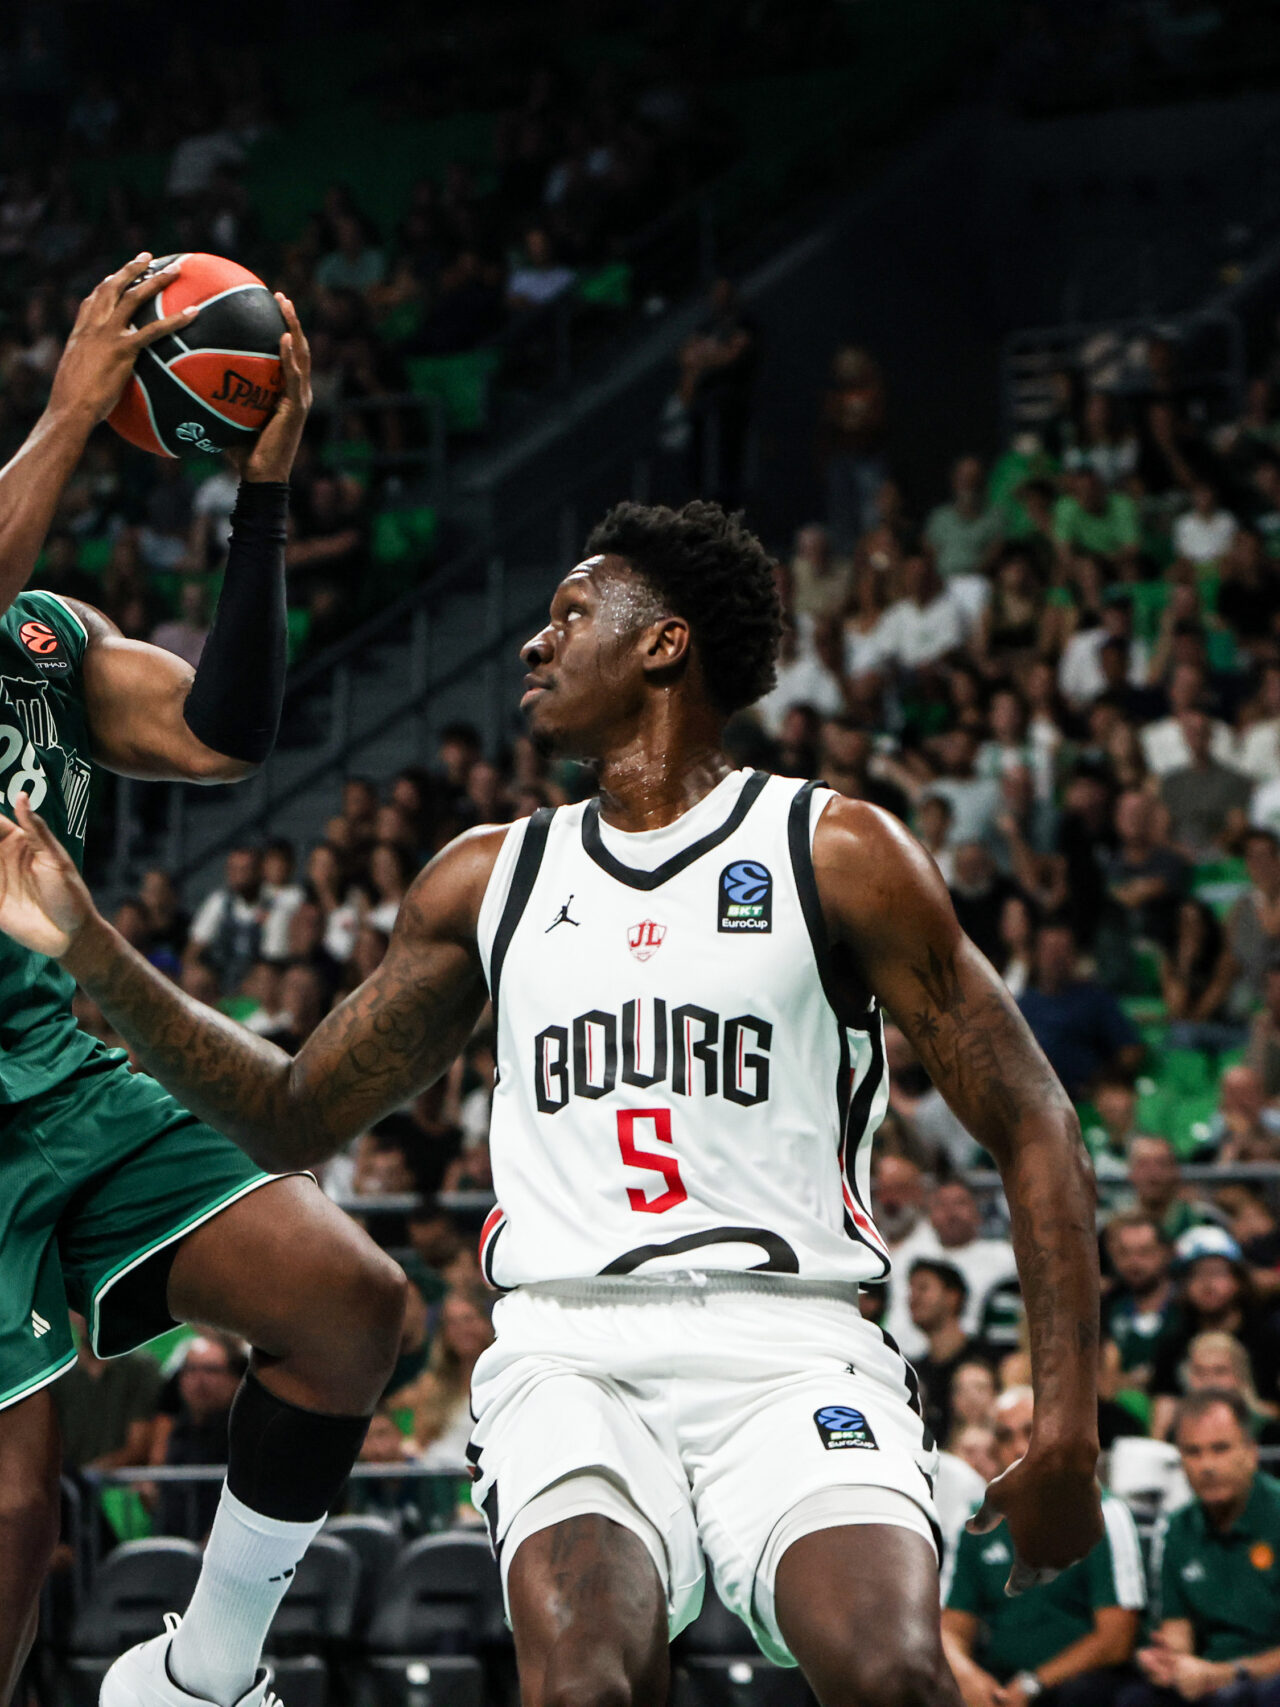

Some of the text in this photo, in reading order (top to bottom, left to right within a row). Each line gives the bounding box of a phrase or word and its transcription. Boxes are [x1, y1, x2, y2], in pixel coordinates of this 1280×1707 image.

[727, 904, 763, 917] BKT
[721, 917, 769, 930] EuroCup
[630, 922, 662, 948] JL
[534, 997, 773, 1115] BOURG
[616, 1108, 689, 1215] 5
[828, 1439, 875, 1449] EuroCup
